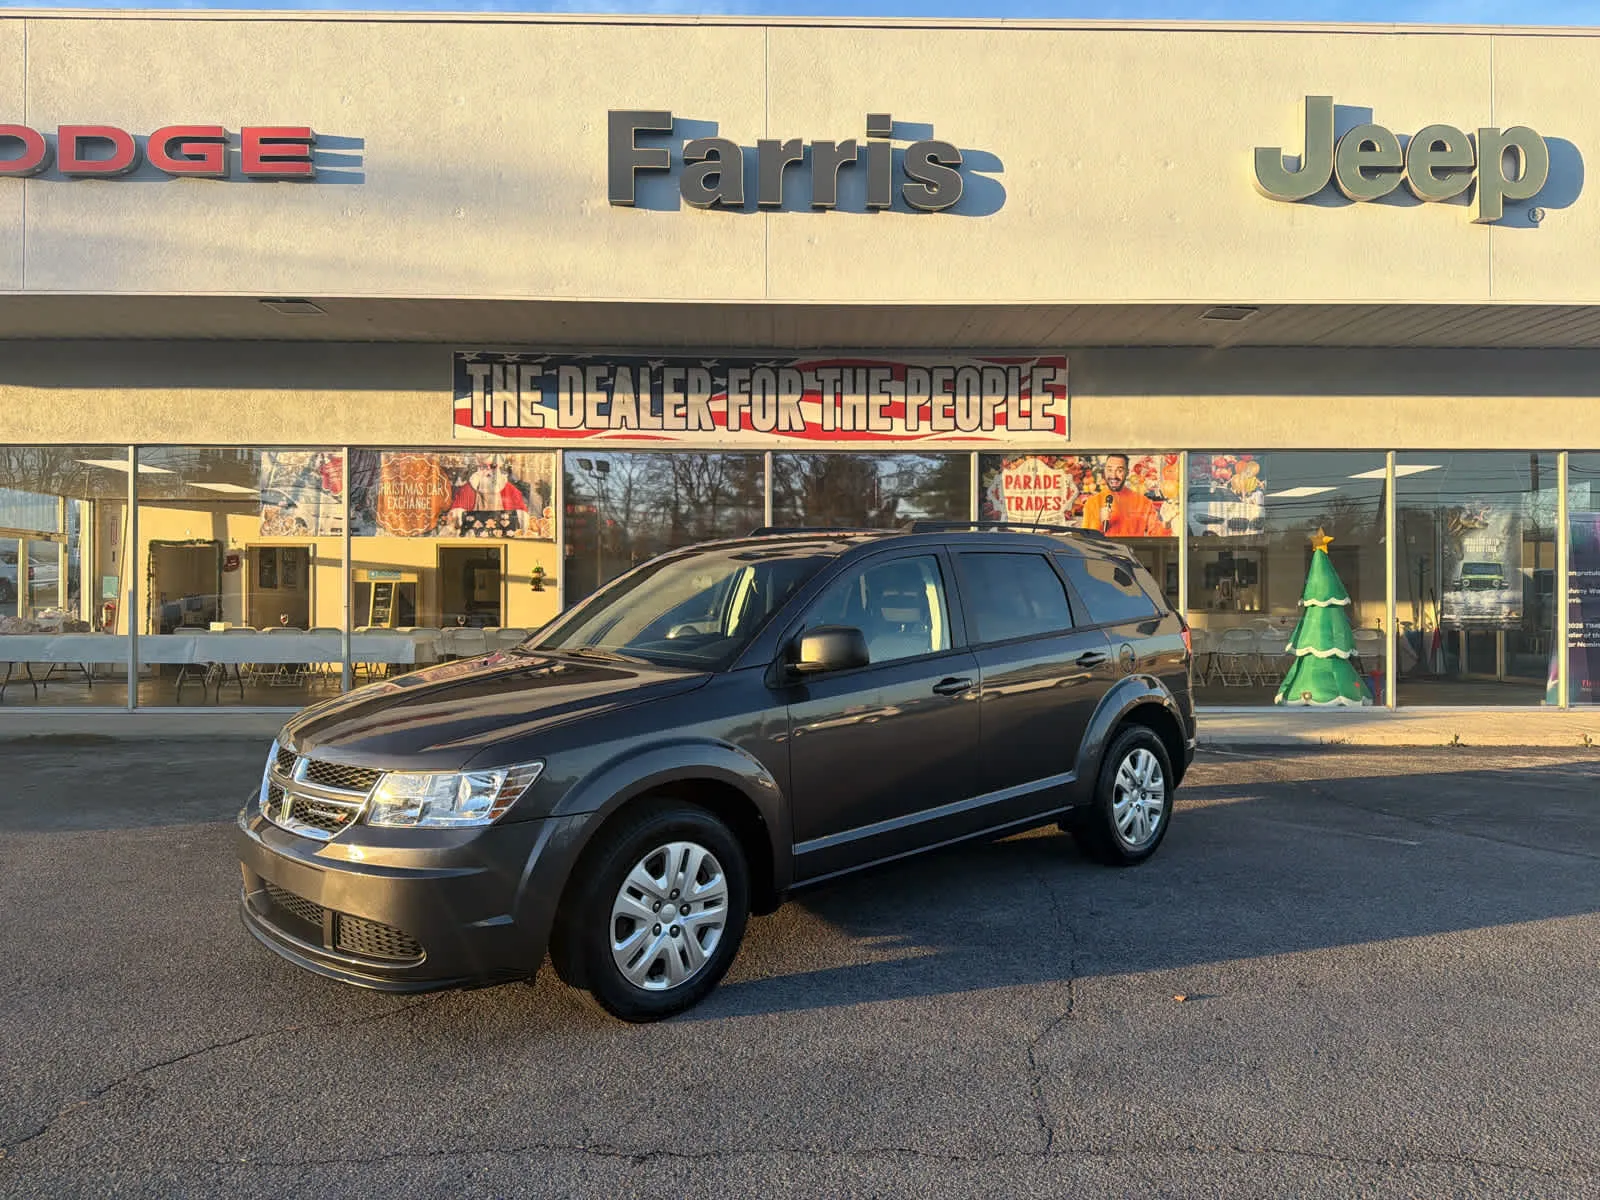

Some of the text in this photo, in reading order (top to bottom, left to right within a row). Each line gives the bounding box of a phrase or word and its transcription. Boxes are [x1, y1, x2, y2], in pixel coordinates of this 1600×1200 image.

[608, 110, 964, 211] Farris
[1253, 95, 1550, 224] Jeep
[464, 361, 1057, 432] THE DEALER FOR THE PEOPLE
[426, 482, 444, 497] CAR
[1004, 473, 1062, 490] PARADE
[387, 496, 432, 510] EXCHANGE
[1004, 495, 1062, 511] TRADES
